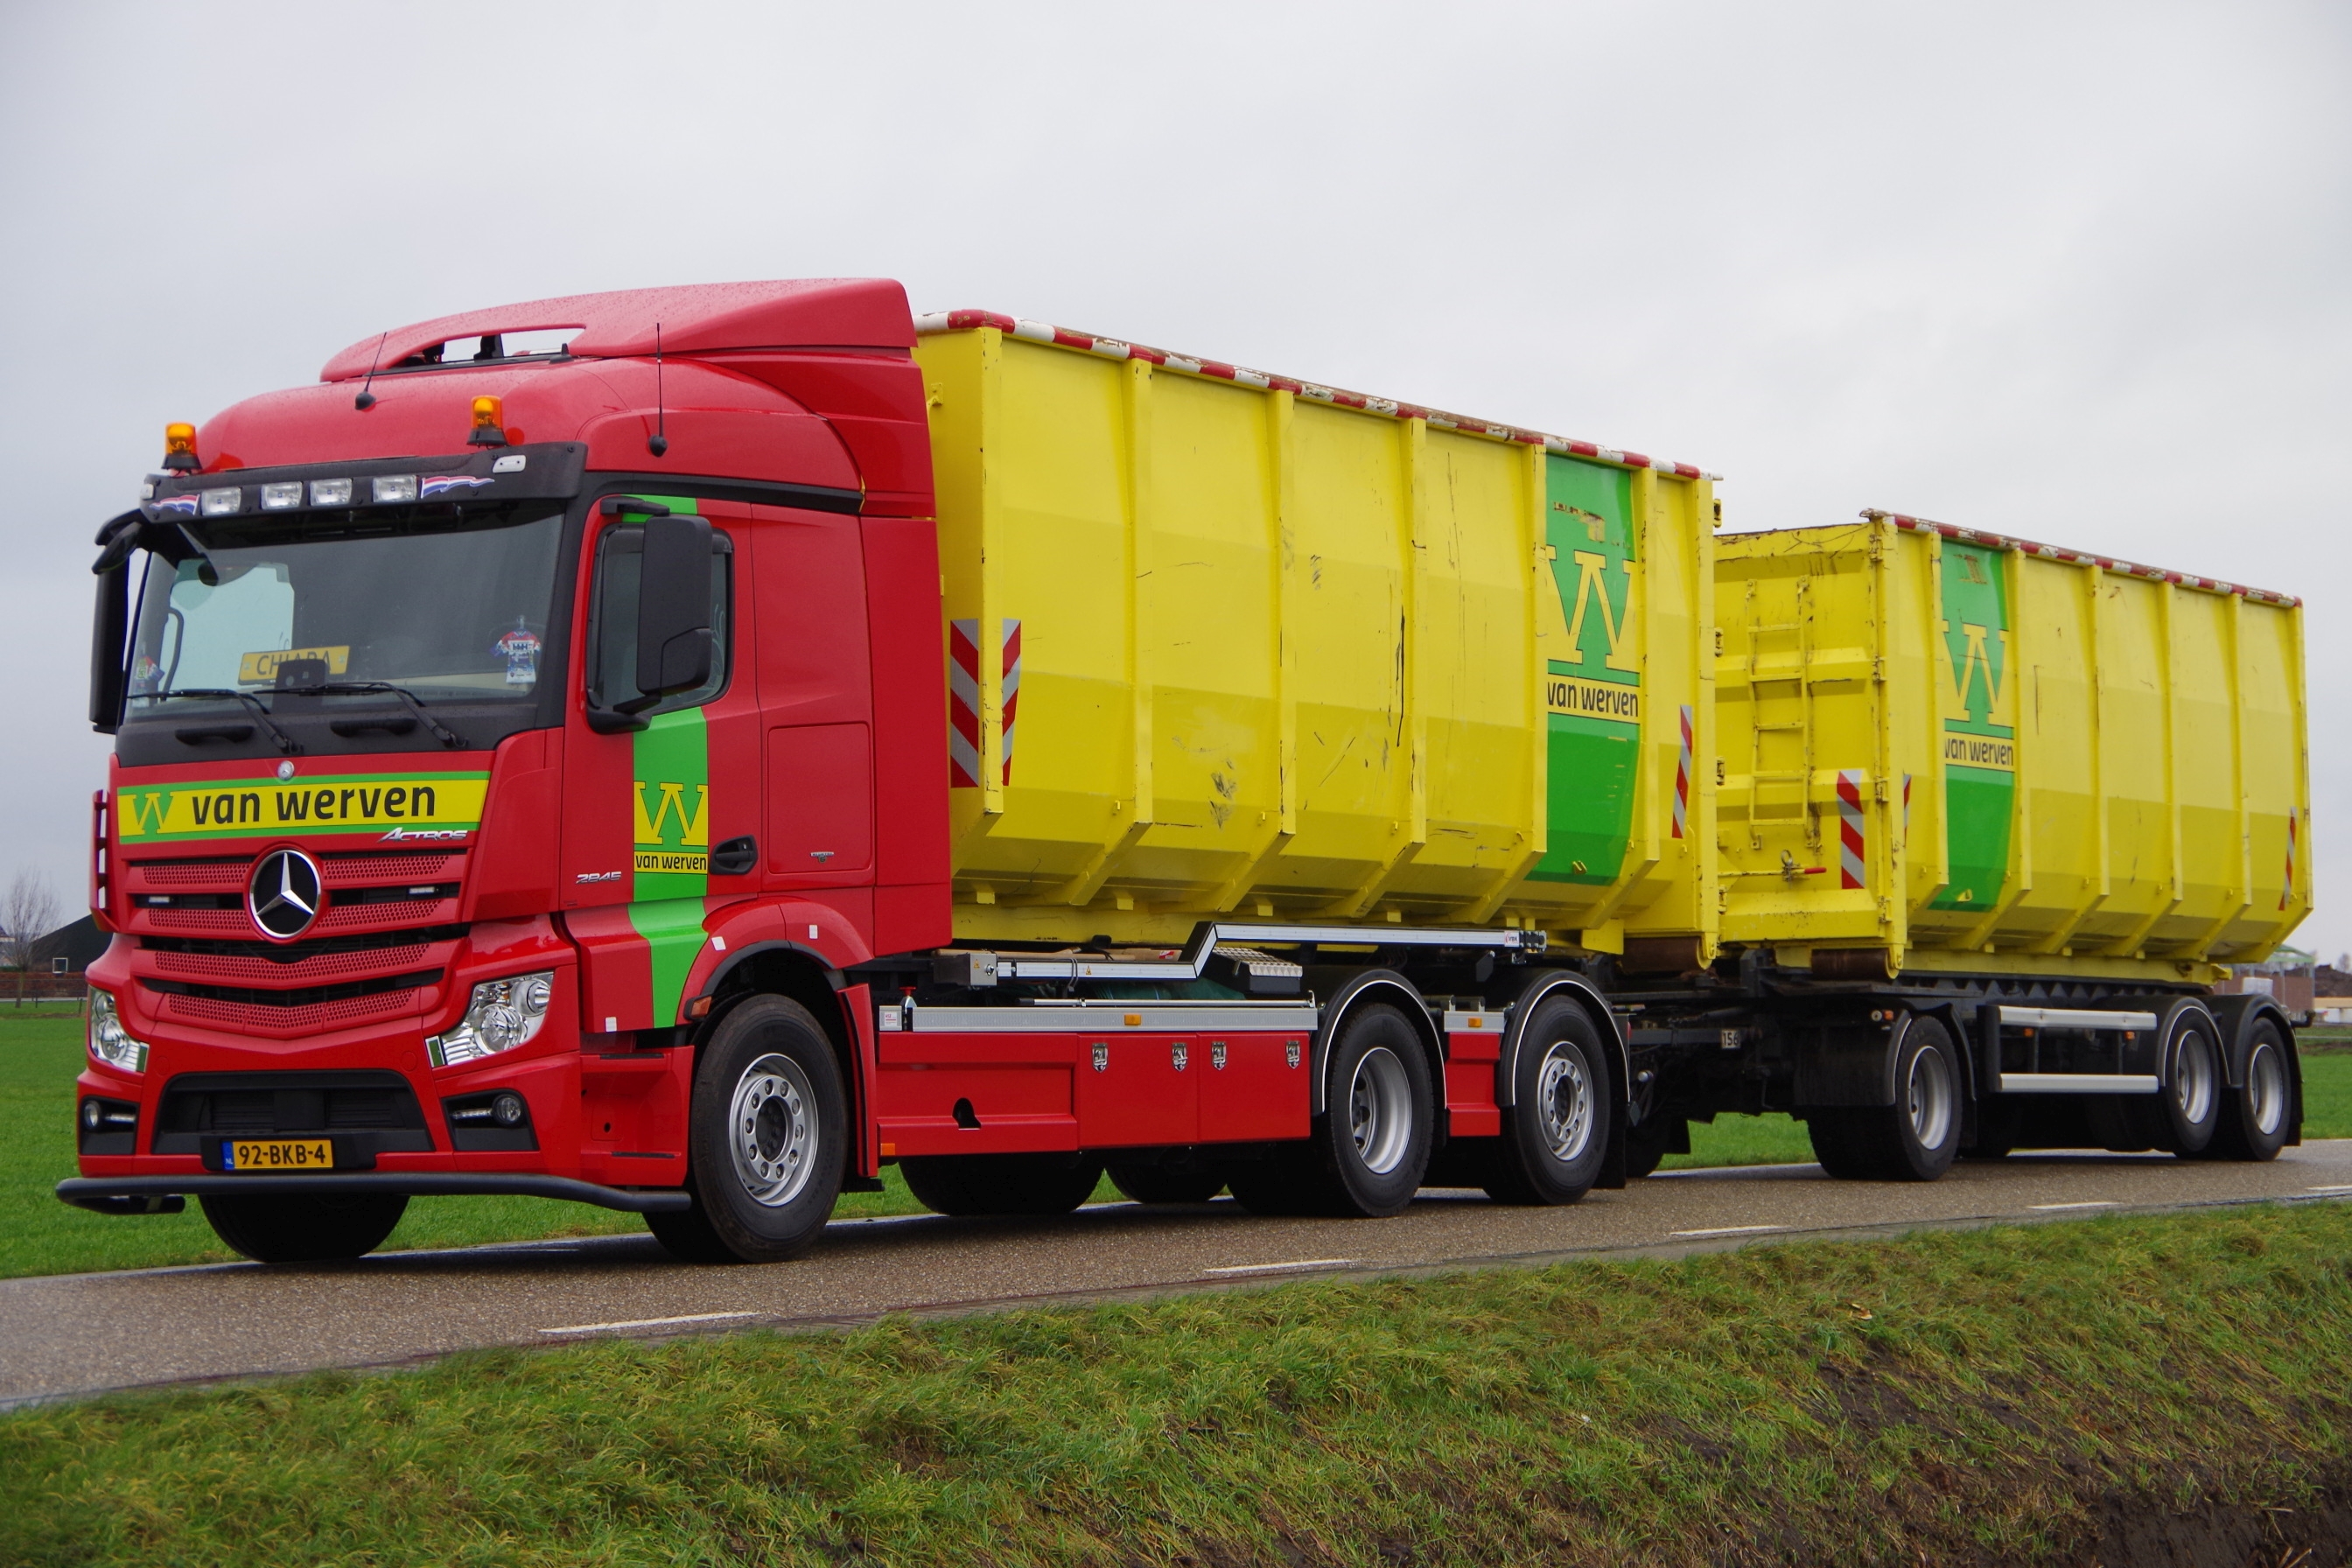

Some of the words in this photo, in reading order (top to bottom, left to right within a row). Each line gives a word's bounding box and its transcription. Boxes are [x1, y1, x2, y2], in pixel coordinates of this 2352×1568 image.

[1547, 682, 1577, 709] van
[1581, 686, 1639, 718] werven
[1969, 741, 2014, 766] werven
[192, 792, 261, 825] van
[276, 786, 436, 821] werven
[635, 855, 659, 869] van
[662, 856, 707, 871] werven
[576, 872, 622, 884] 2845
[1723, 1032, 1740, 1046] 156
[238, 1144, 326, 1166] 92-BKB-4
